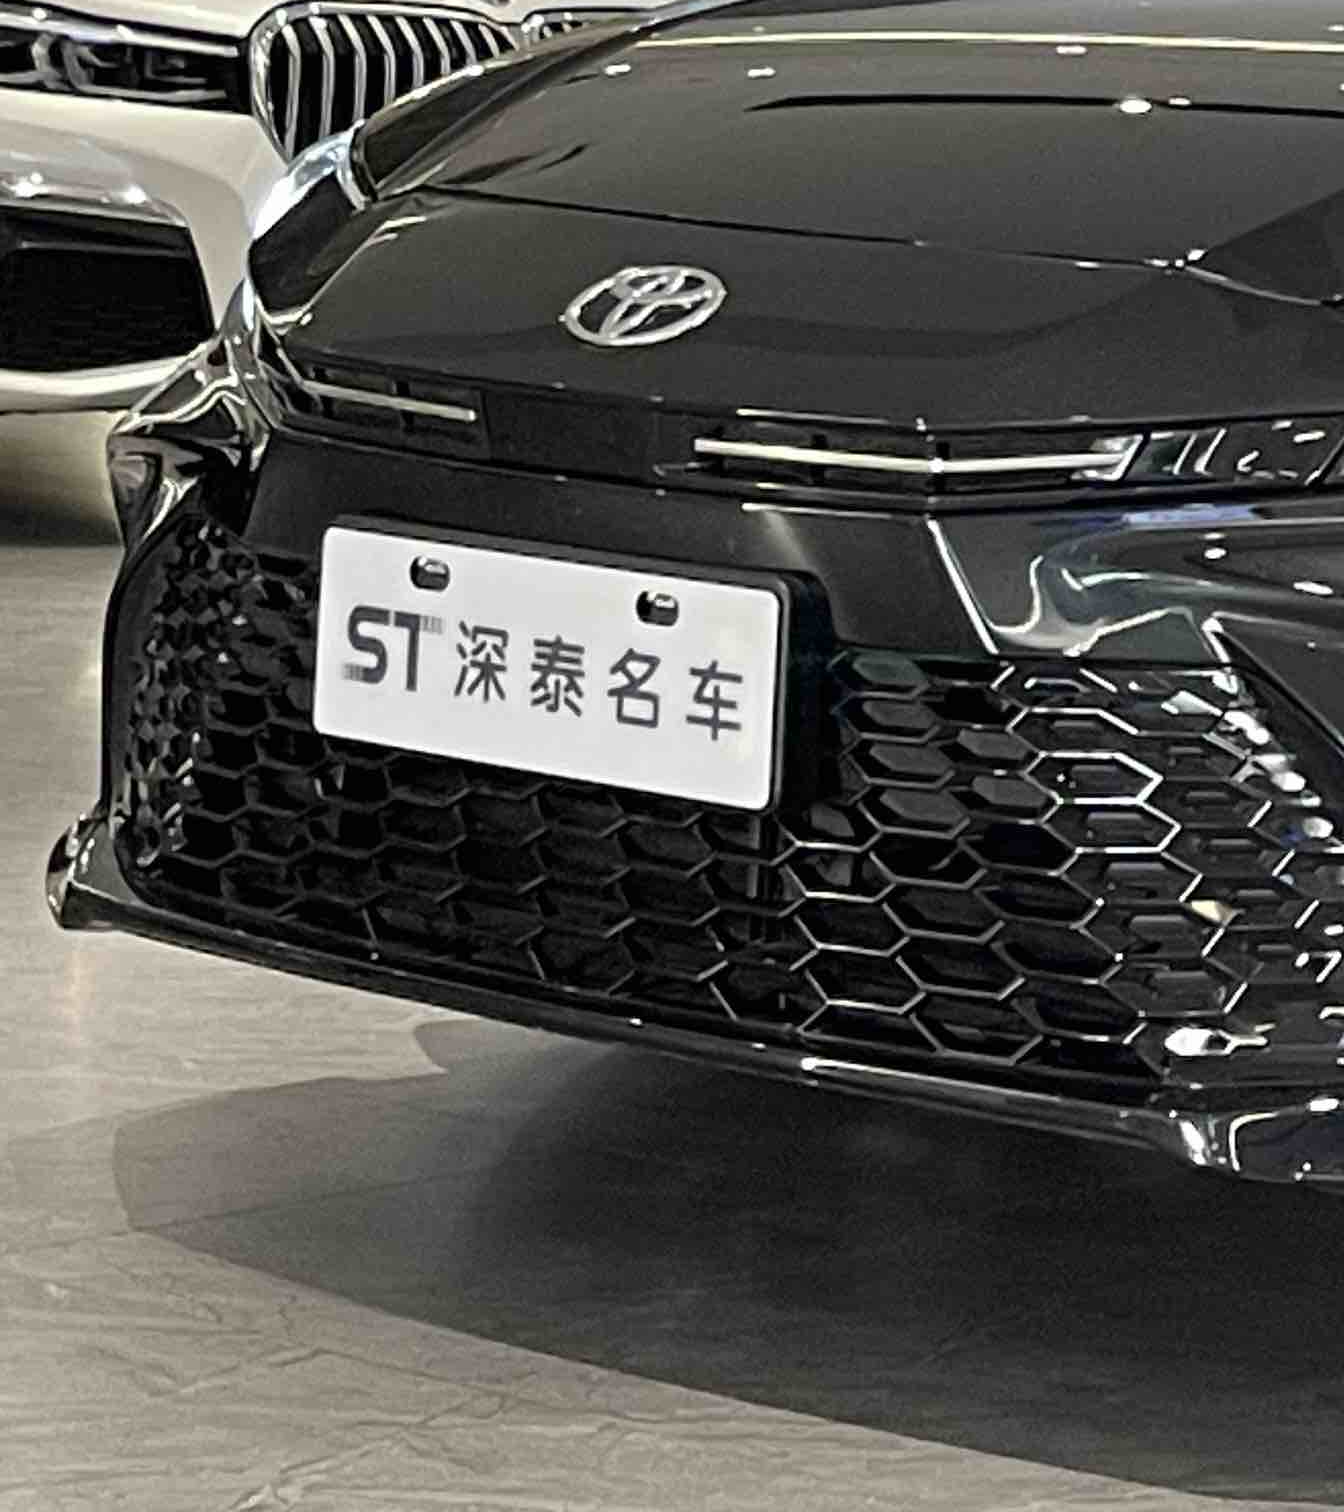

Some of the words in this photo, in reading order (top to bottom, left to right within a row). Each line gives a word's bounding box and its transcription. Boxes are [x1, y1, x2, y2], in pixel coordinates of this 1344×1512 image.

[342, 604, 443, 693] ST
[454, 620, 743, 740] 深泰名车
